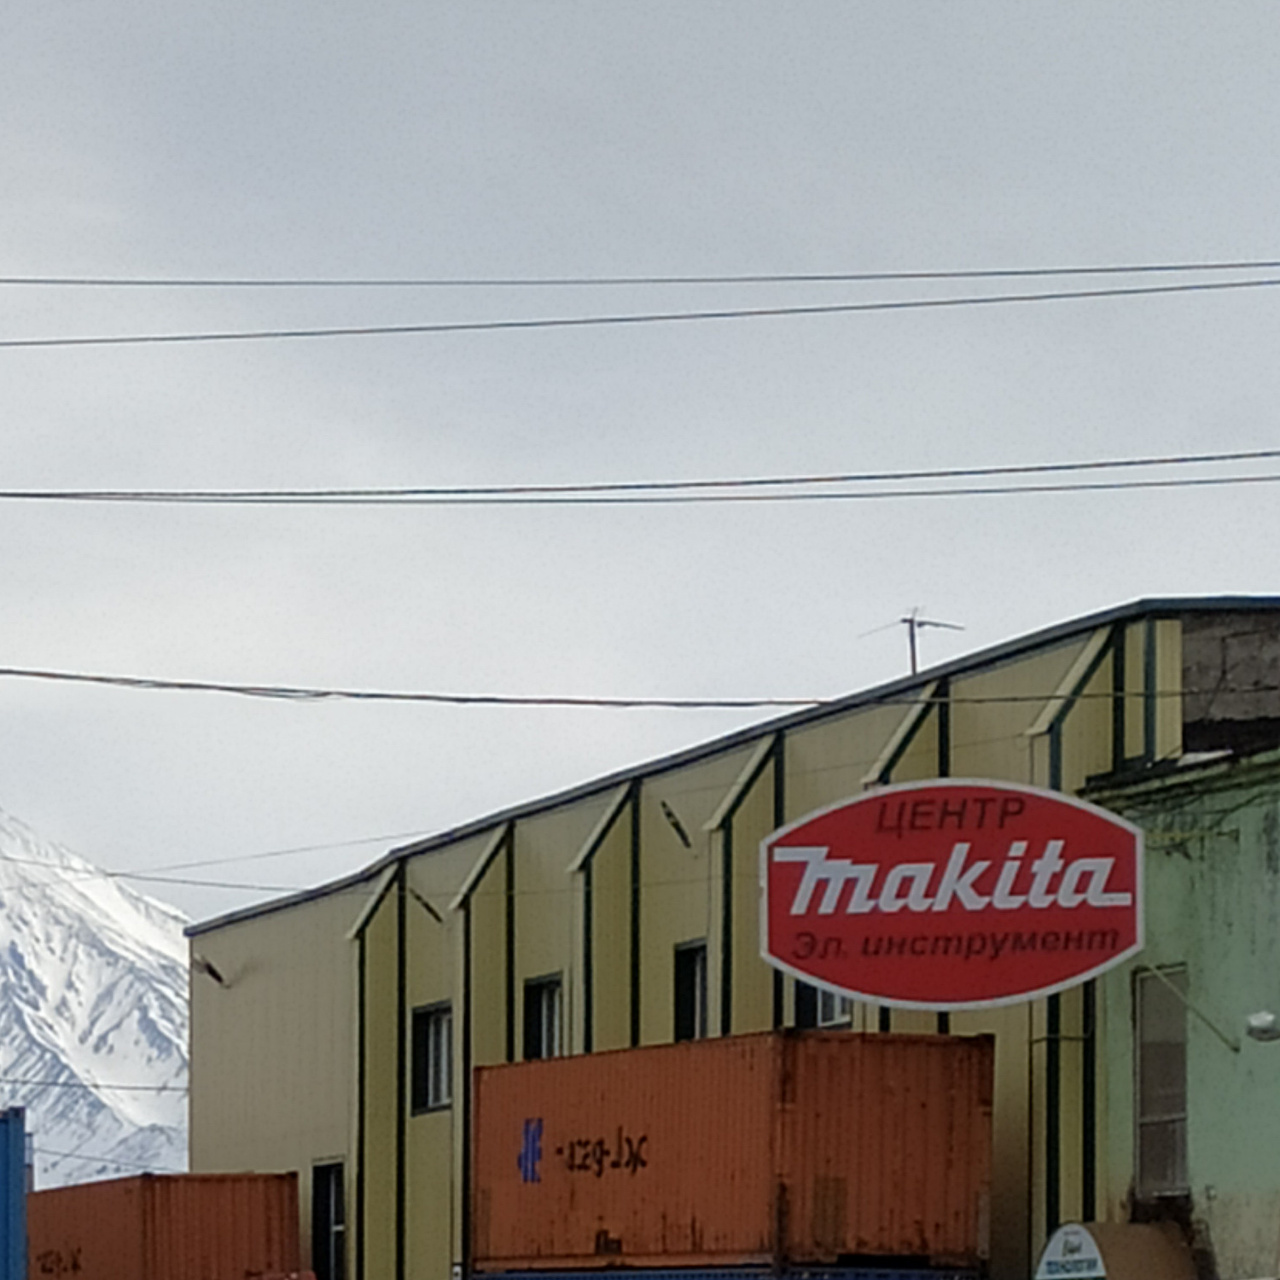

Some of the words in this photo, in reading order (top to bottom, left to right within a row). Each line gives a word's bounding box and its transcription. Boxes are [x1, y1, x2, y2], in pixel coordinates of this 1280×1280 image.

[876, 797, 1026, 839] ЦЕНТР
[772, 839, 1133, 916] makita
[792, 932, 851, 961] Эл.
[860, 926, 1119, 963] инструмент
